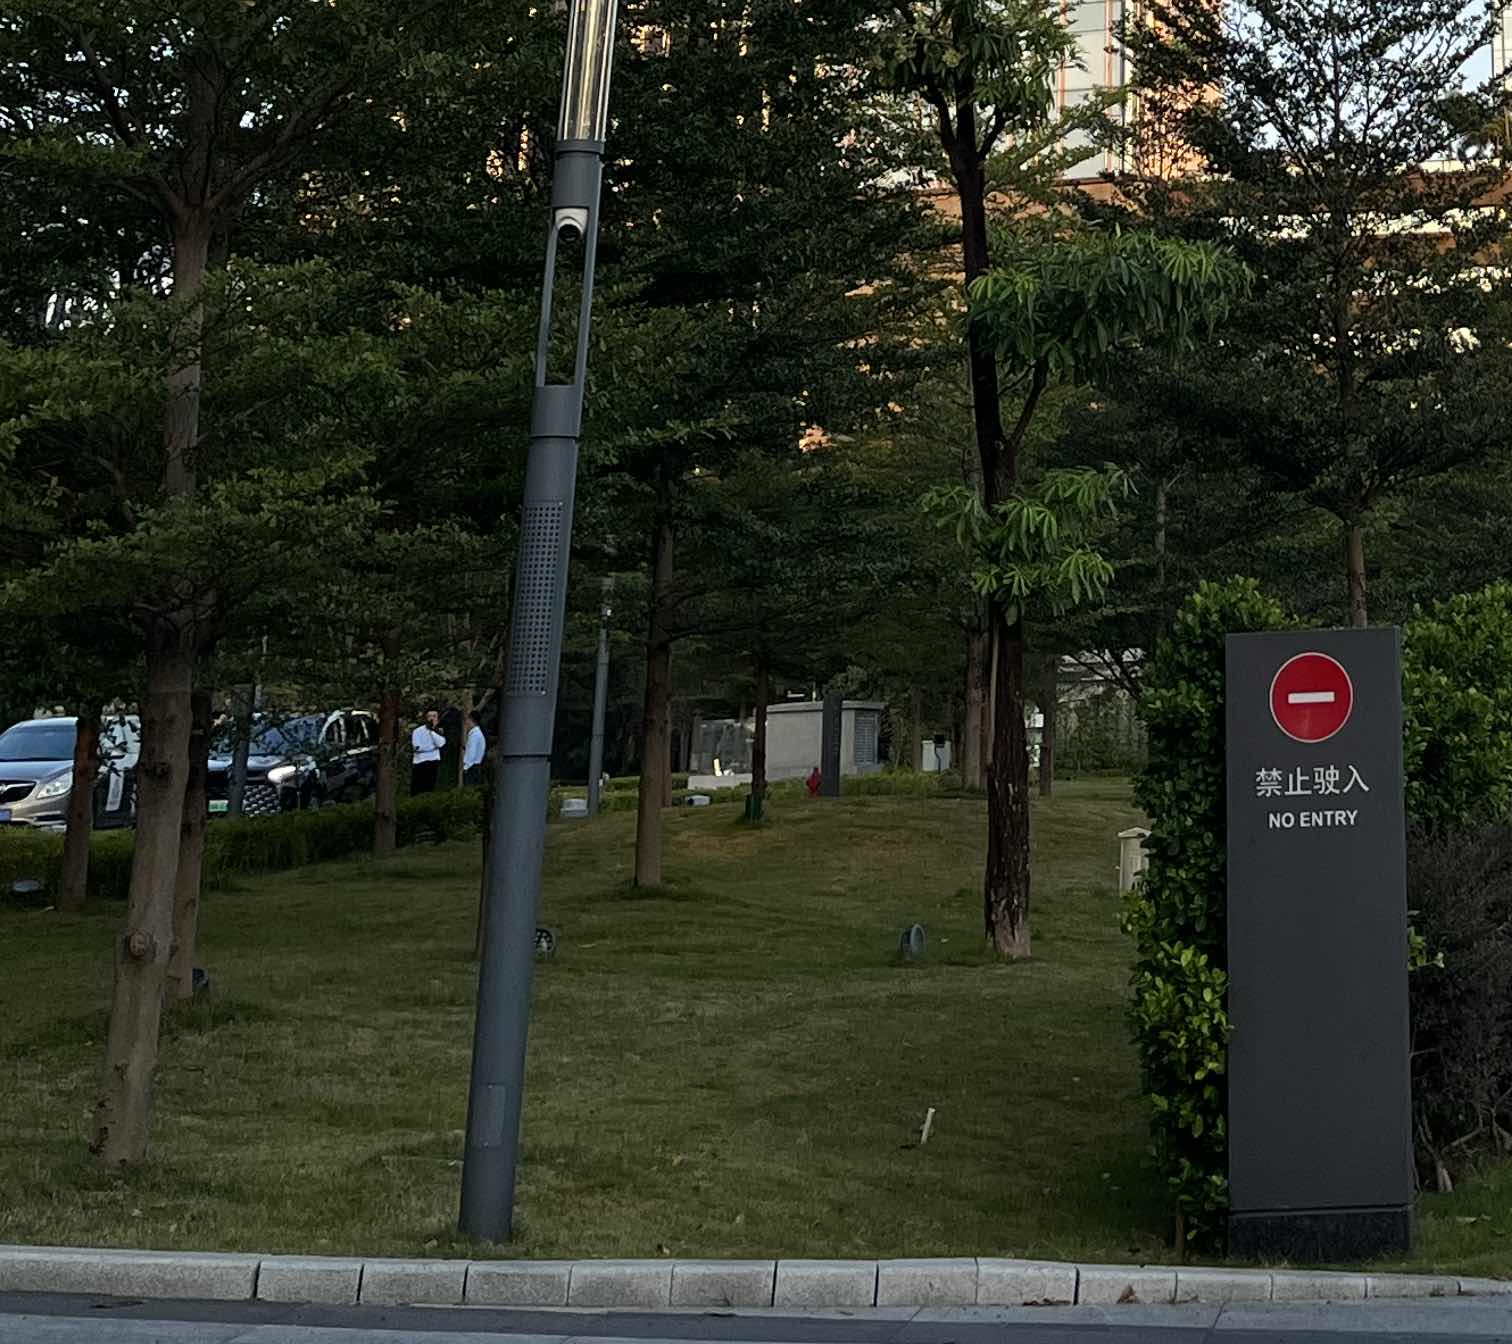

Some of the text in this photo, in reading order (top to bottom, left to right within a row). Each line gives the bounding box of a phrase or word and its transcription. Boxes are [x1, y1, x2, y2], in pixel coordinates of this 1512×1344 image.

[1255, 764, 1370, 798] 禁止驶入
[1268, 809, 1359, 829] NO ENTRY
